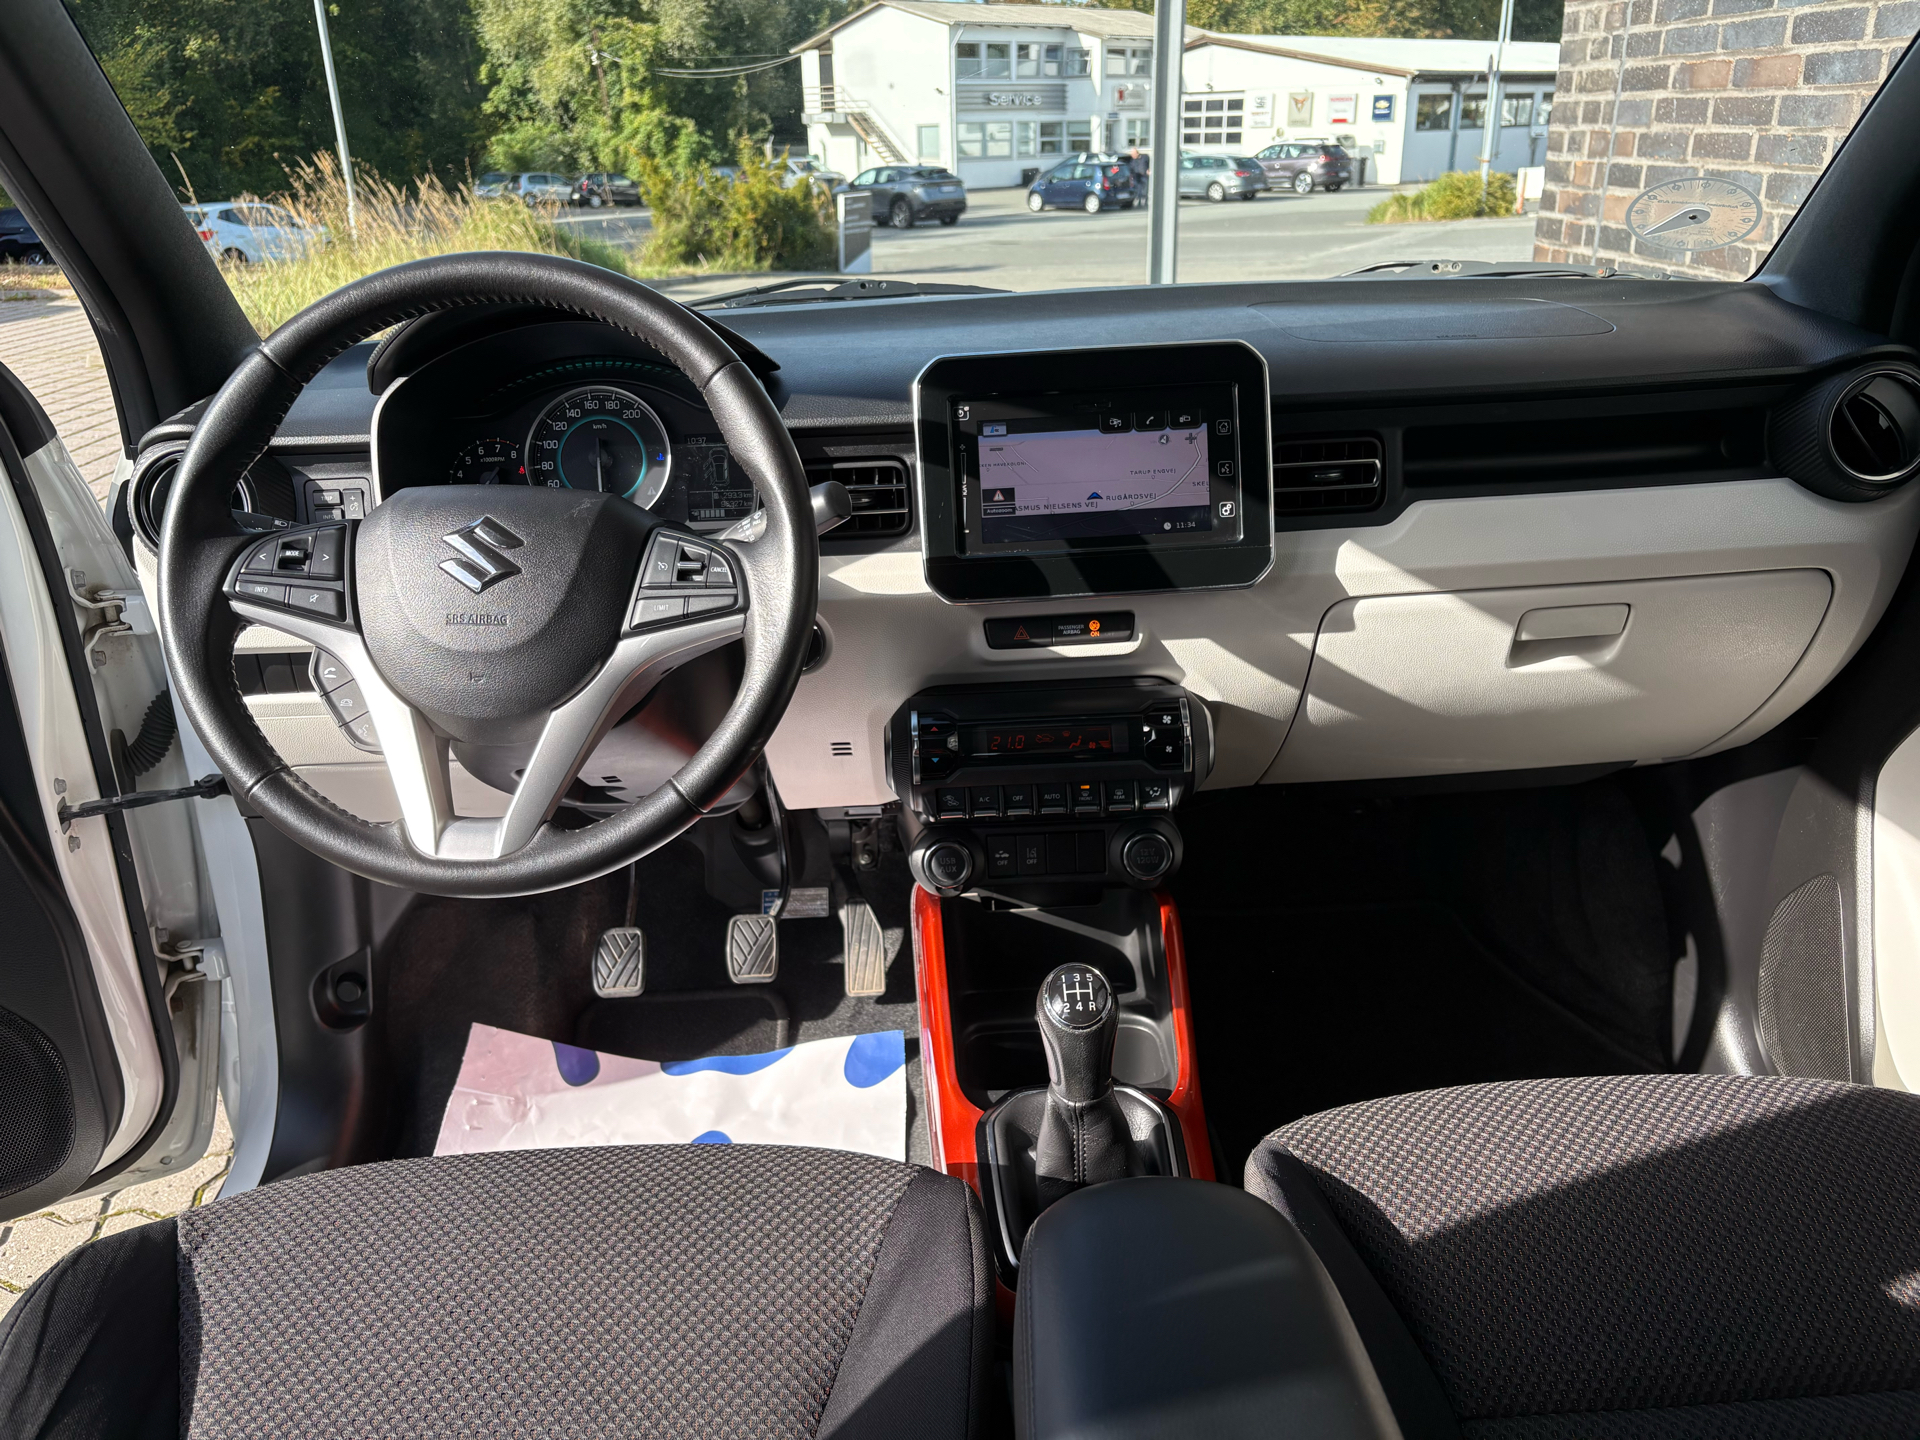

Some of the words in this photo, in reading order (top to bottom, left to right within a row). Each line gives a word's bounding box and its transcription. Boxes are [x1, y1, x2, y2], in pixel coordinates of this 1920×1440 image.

[989, 92, 1042, 106] Service
[584, 401, 599, 410] 160
[605, 401, 620, 410] 180
[566, 409, 581, 418] 140
[622, 409, 641, 419] 200
[552, 422, 568, 431] 120
[495, 445, 501, 453] 7
[543, 440, 559, 449] 100
[478, 447, 484, 455] 6
[510, 451, 517, 459] 8
[465, 457, 472, 465] 5
[541, 462, 554, 470] 80
[457, 470, 463, 478] 4
[547, 479, 560, 488] 60
[1106, 492, 1157, 501] RUGÅRDSVEJ
[1084, 501, 1098, 509] VEJ
[1176, 521, 1196, 529] 11:34
[446, 613, 465, 624] SRS
[468, 614, 508, 625] AIRBAG
[990, 734, 1025, 750] 21.0
[939, 857, 956, 865] USB
[939, 865, 957, 873] AUX
[1073, 973, 1080, 981] 3
[1063, 1003, 1070, 1012] 2
[1076, 1002, 1083, 1011] 4
[1089, 1002, 1096, 1011] R
